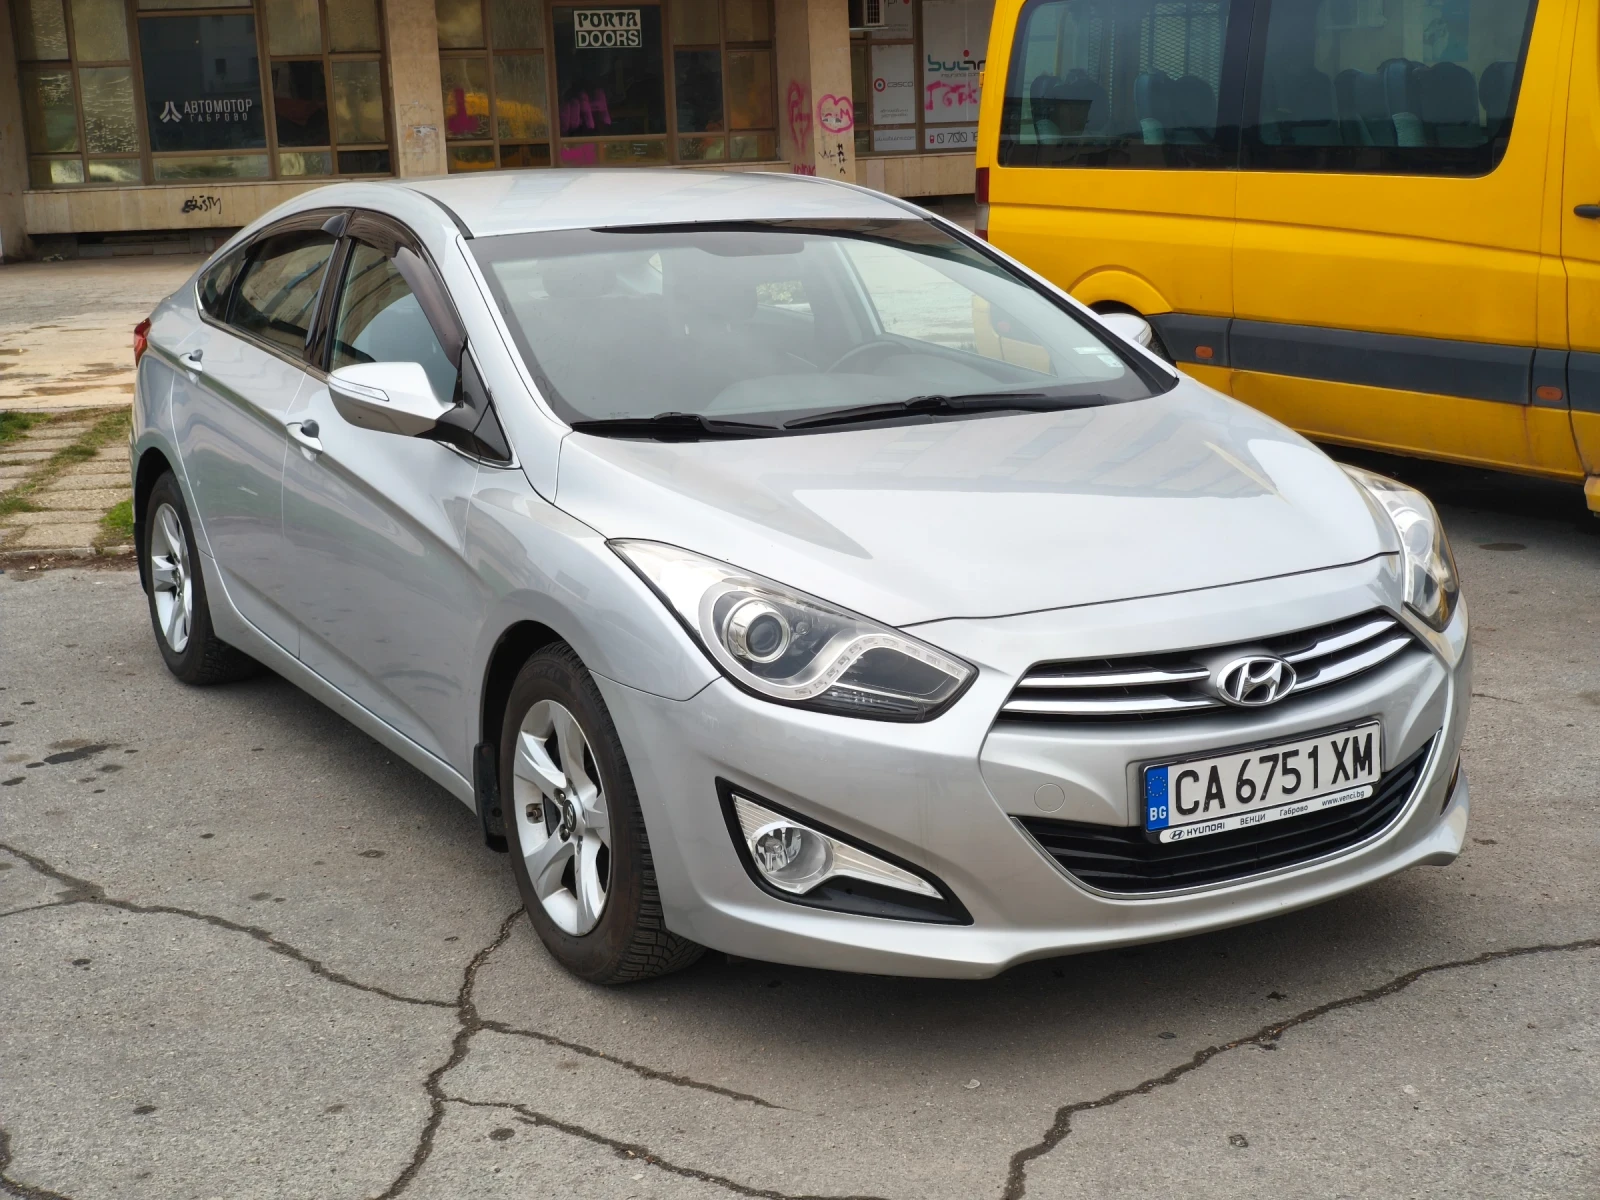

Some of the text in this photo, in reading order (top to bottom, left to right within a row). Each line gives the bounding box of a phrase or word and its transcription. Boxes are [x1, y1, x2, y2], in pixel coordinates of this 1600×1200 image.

[576, 12, 639, 28] PORTA
[577, 30, 639, 47] DOORS
[184, 99, 252, 113] АВТОМОТОР
[190, 113, 248, 122] ГАБРОВО
[936, 133, 945, 144] 0
[947, 131, 968, 143] 700
[1175, 732, 1373, 816] CA 6751 XM
[1149, 805, 1167, 822] BG
[1186, 789, 1365, 837] HYUNDAI ВЕНЦИ Габрово www.venci.bg
